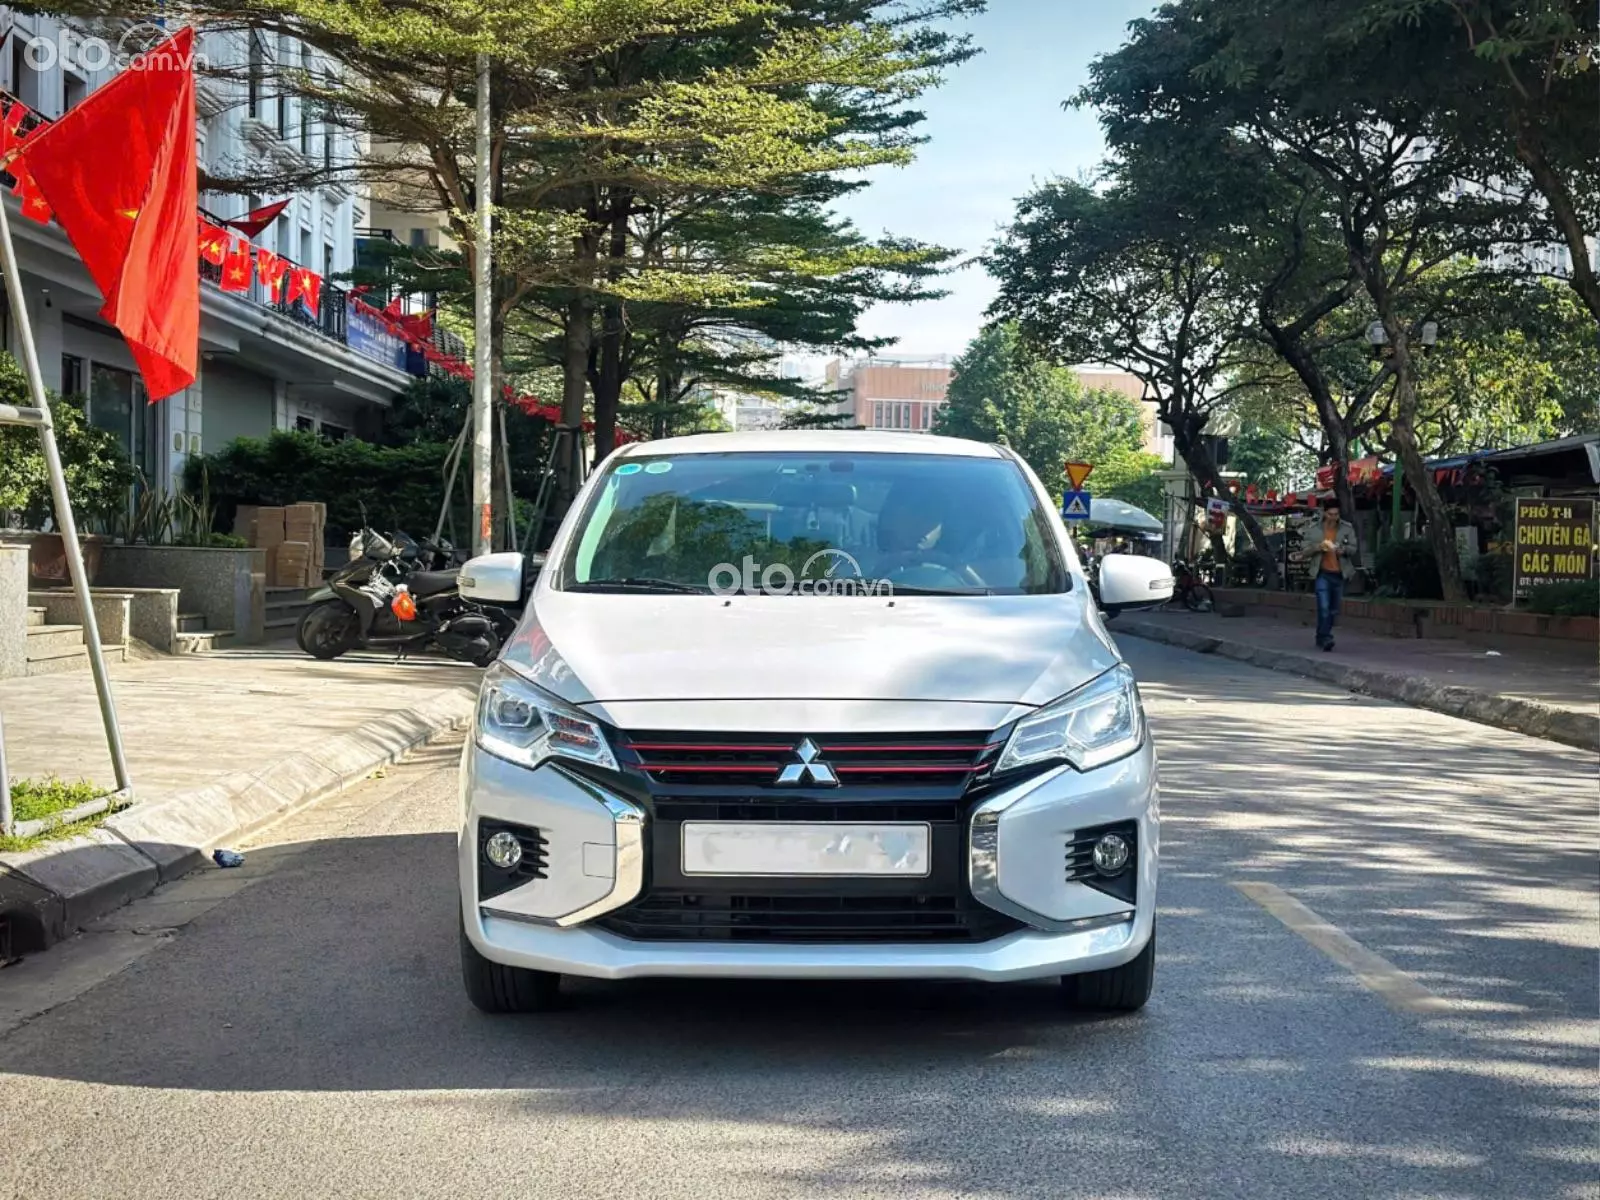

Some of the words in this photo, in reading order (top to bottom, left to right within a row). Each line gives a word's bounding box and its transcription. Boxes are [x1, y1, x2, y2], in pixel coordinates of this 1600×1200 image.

[1519, 502, 1549, 519] PHỞ
[1518, 522, 1570, 546] CHUYÊN
[1573, 523, 1592, 547] GÀ
[1522, 550, 1550, 574] CÁC
[1553, 551, 1586, 574] MÓN
